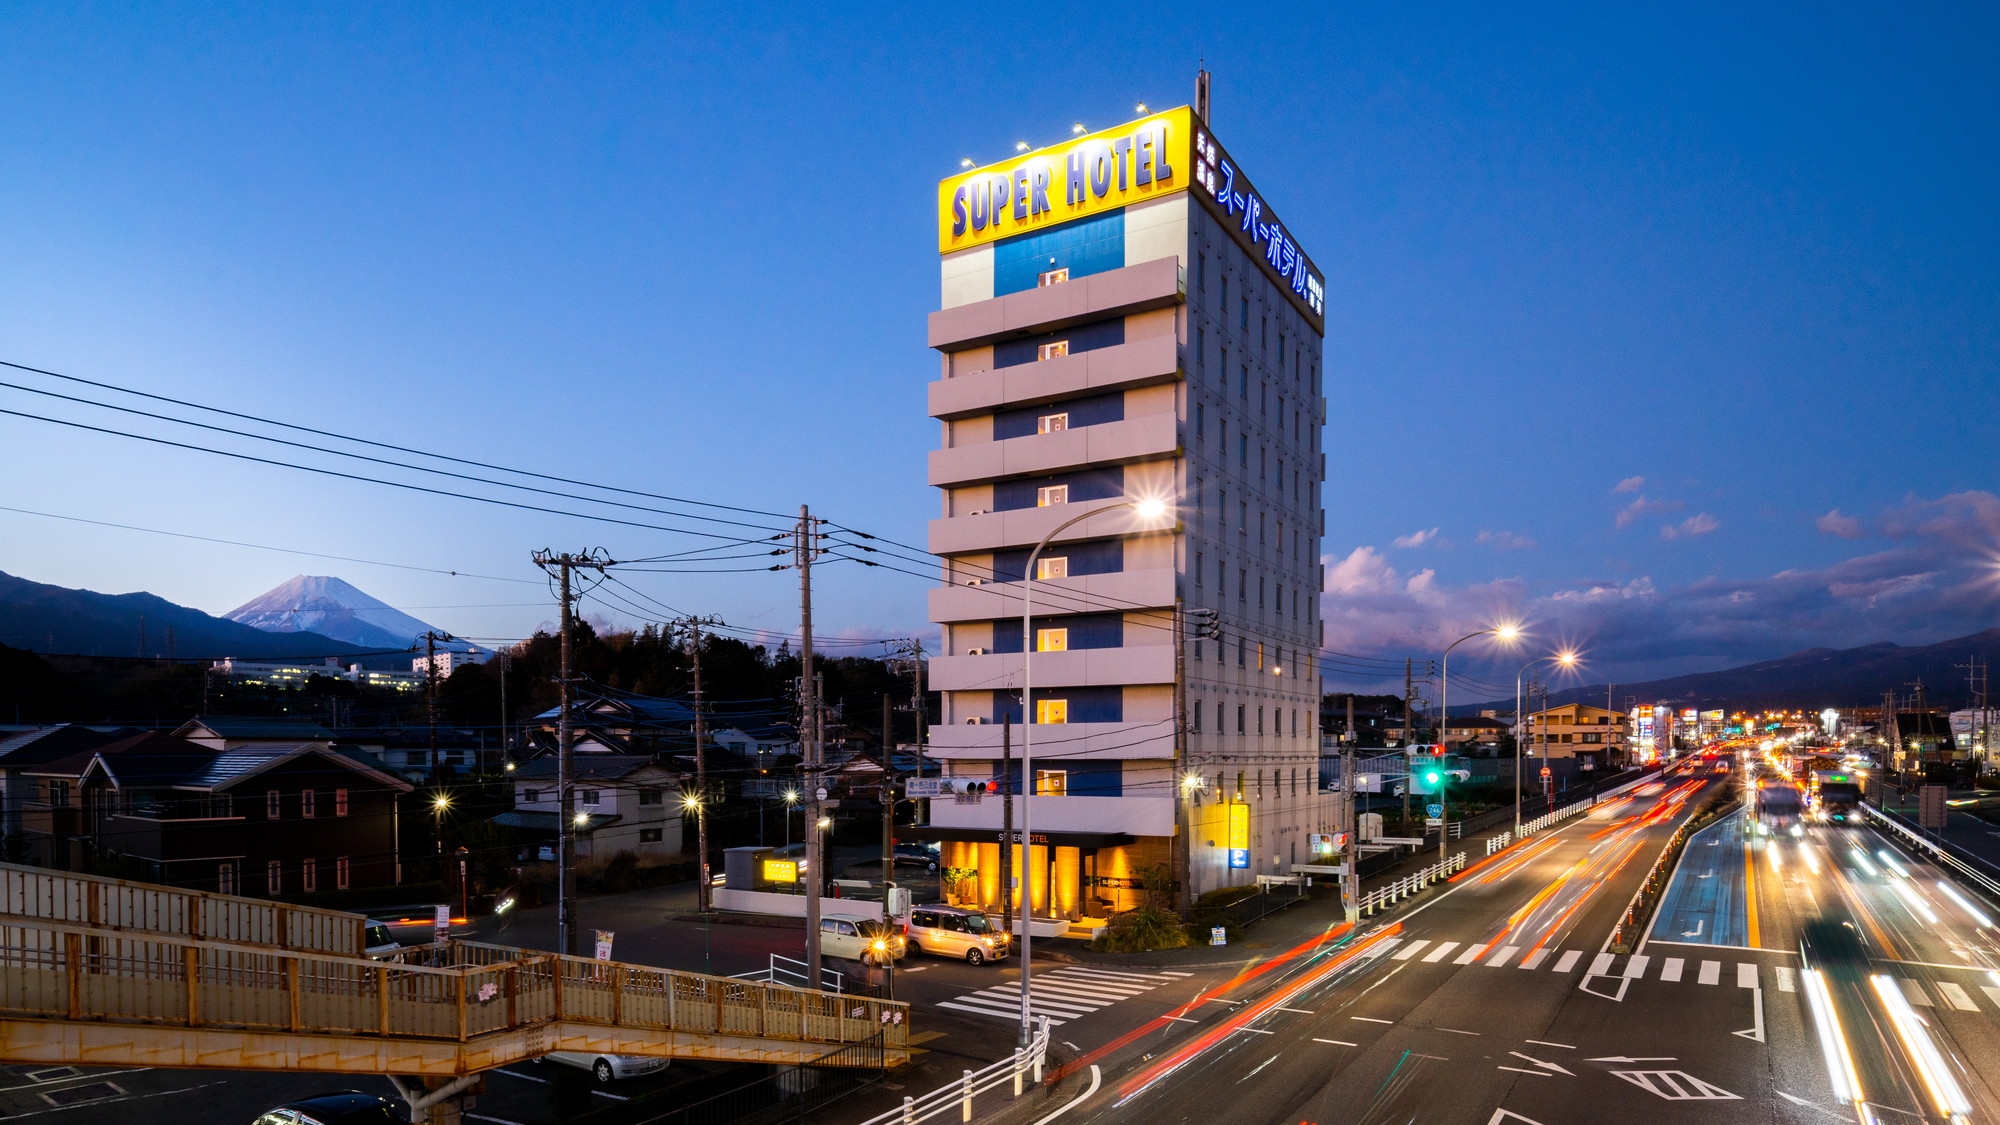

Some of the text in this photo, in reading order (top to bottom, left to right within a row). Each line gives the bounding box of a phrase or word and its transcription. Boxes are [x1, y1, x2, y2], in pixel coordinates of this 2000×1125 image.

[952, 125, 1172, 237] SUPER HOTEL
[1233, 850, 1244, 860] P
